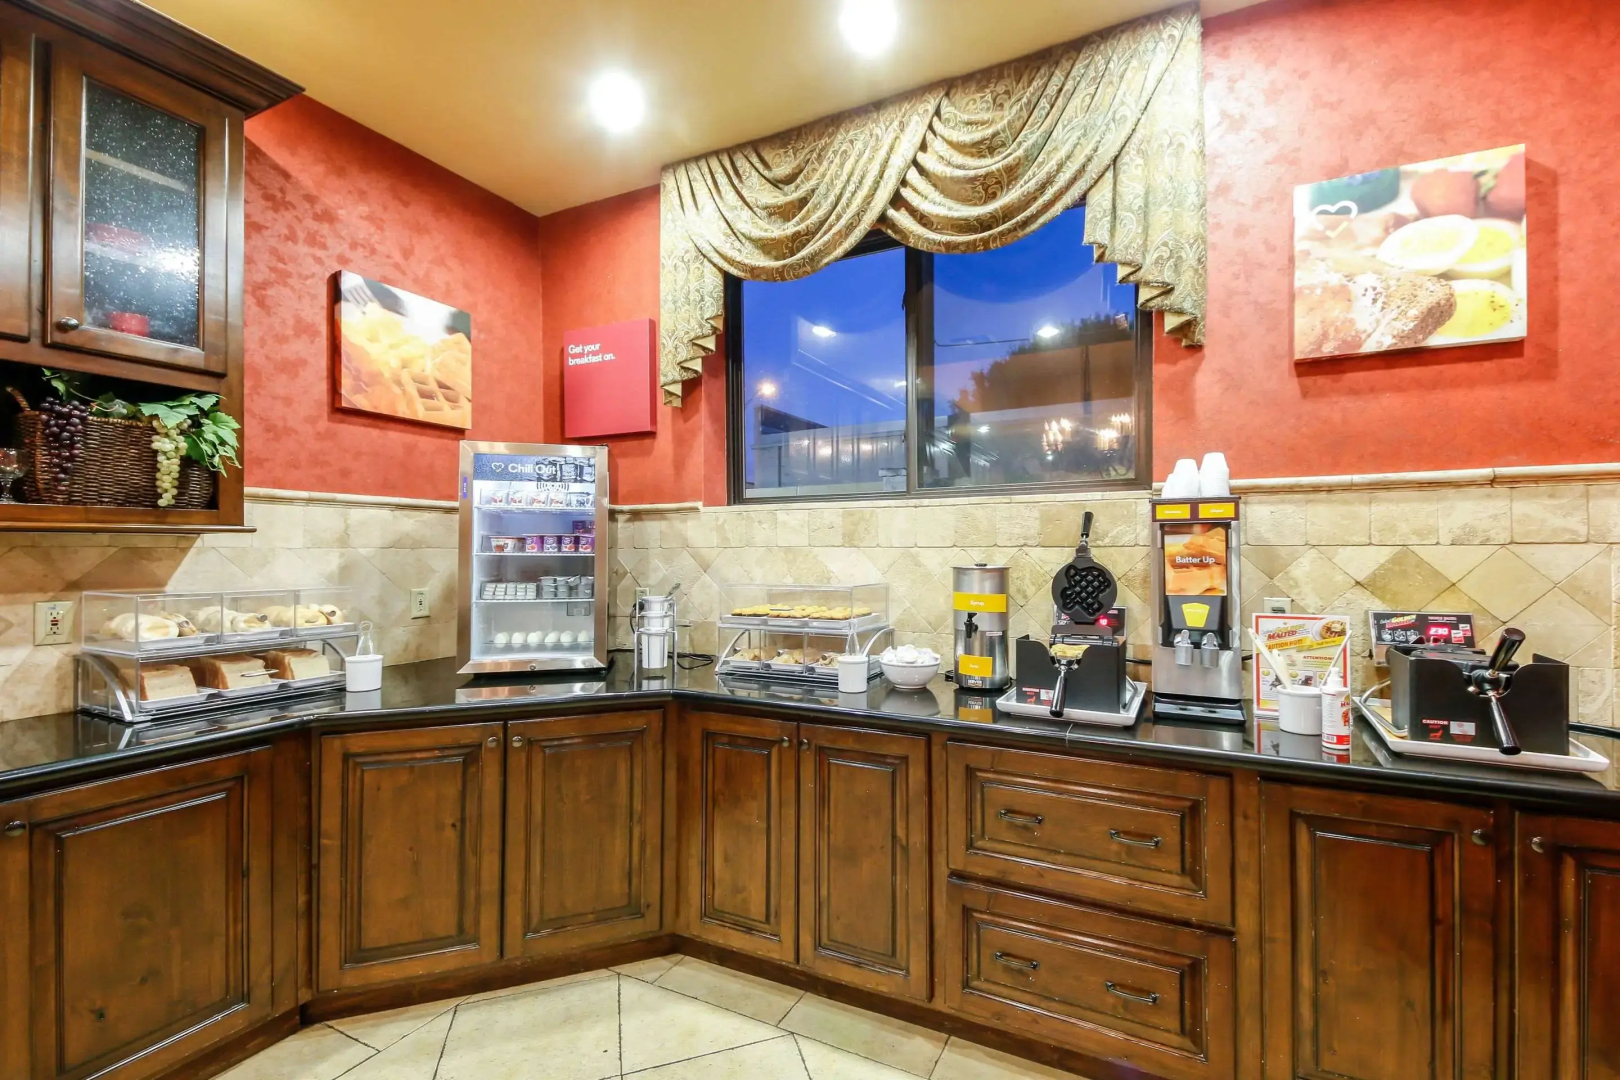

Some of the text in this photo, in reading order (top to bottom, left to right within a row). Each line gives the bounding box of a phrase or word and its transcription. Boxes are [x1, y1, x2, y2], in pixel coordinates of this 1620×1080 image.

[568, 343, 601, 354] Get your
[568, 353, 616, 366] breakfast on.
[508, 463, 558, 475] Chill Out
[1175, 556, 1216, 564] Batter Up
